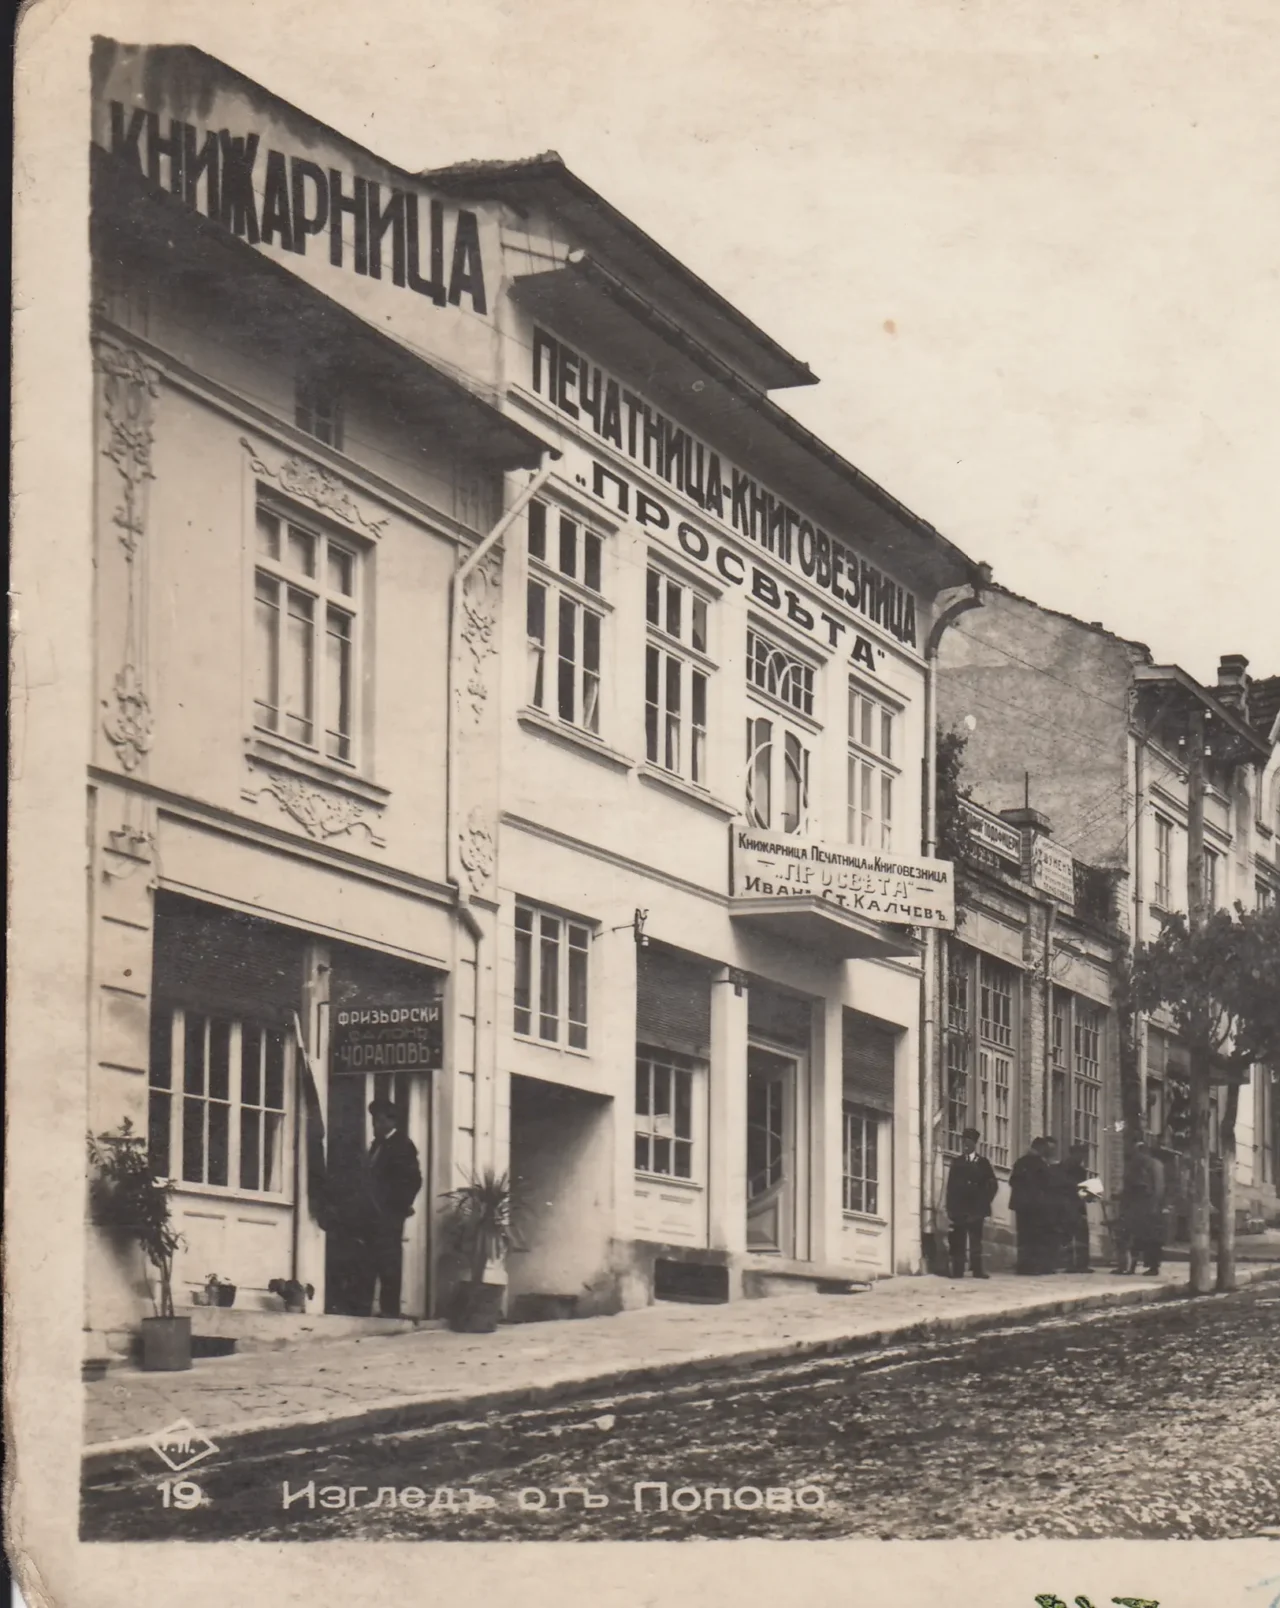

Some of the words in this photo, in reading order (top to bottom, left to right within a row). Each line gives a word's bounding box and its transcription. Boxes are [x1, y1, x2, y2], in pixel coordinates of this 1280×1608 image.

[110, 100, 487, 315] КНИЖАРНИЦА
[738, 832, 808, 861] КНИЖАРНИЦА
[811, 845, 867, 870] ПЕЧАТНИЦА
[874, 856, 948, 884] КНИГОВЕЗНИЦА
[337, 1007, 439, 1026] ФРИЗЬОРСКИ
